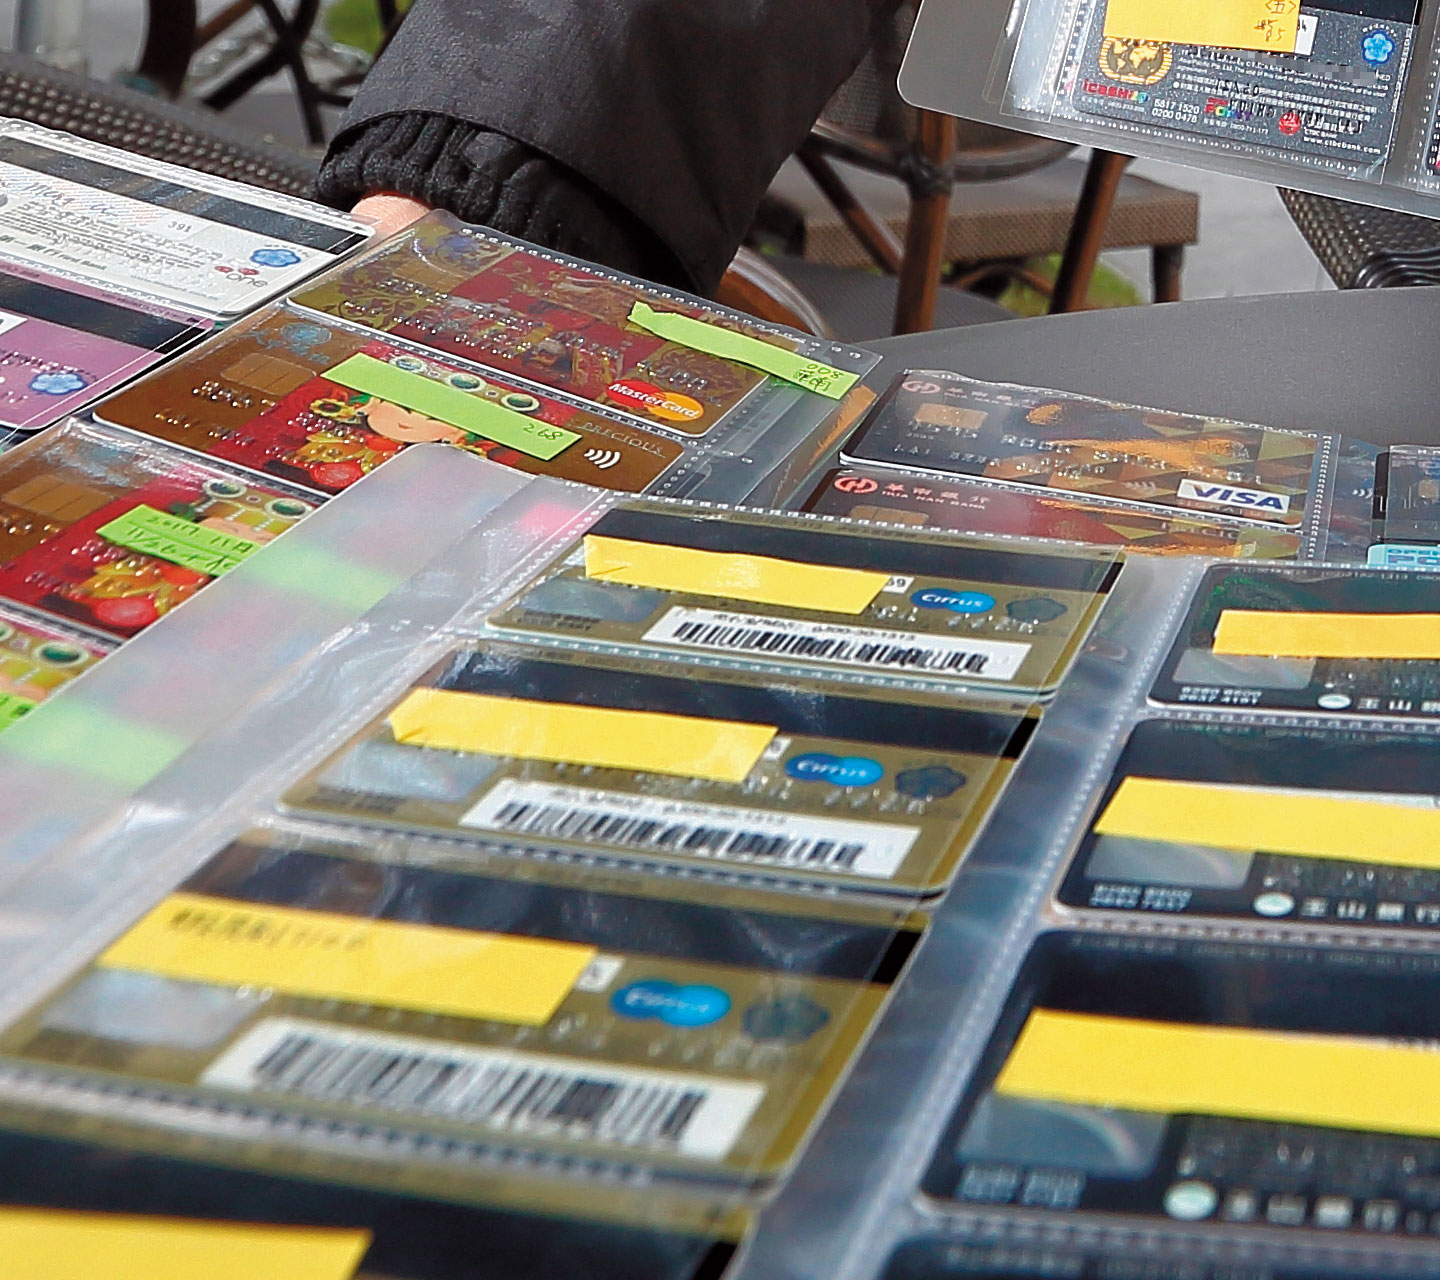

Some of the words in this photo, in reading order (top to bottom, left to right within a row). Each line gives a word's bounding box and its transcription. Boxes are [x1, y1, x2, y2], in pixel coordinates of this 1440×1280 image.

[167, 220, 192, 235] 391
[609, 383, 703, 419] MasterCard
[581, 421, 665, 457] PRECIOUS
[1191, 484, 1286, 513] VISA
[919, 589, 986, 609] Cirrus
